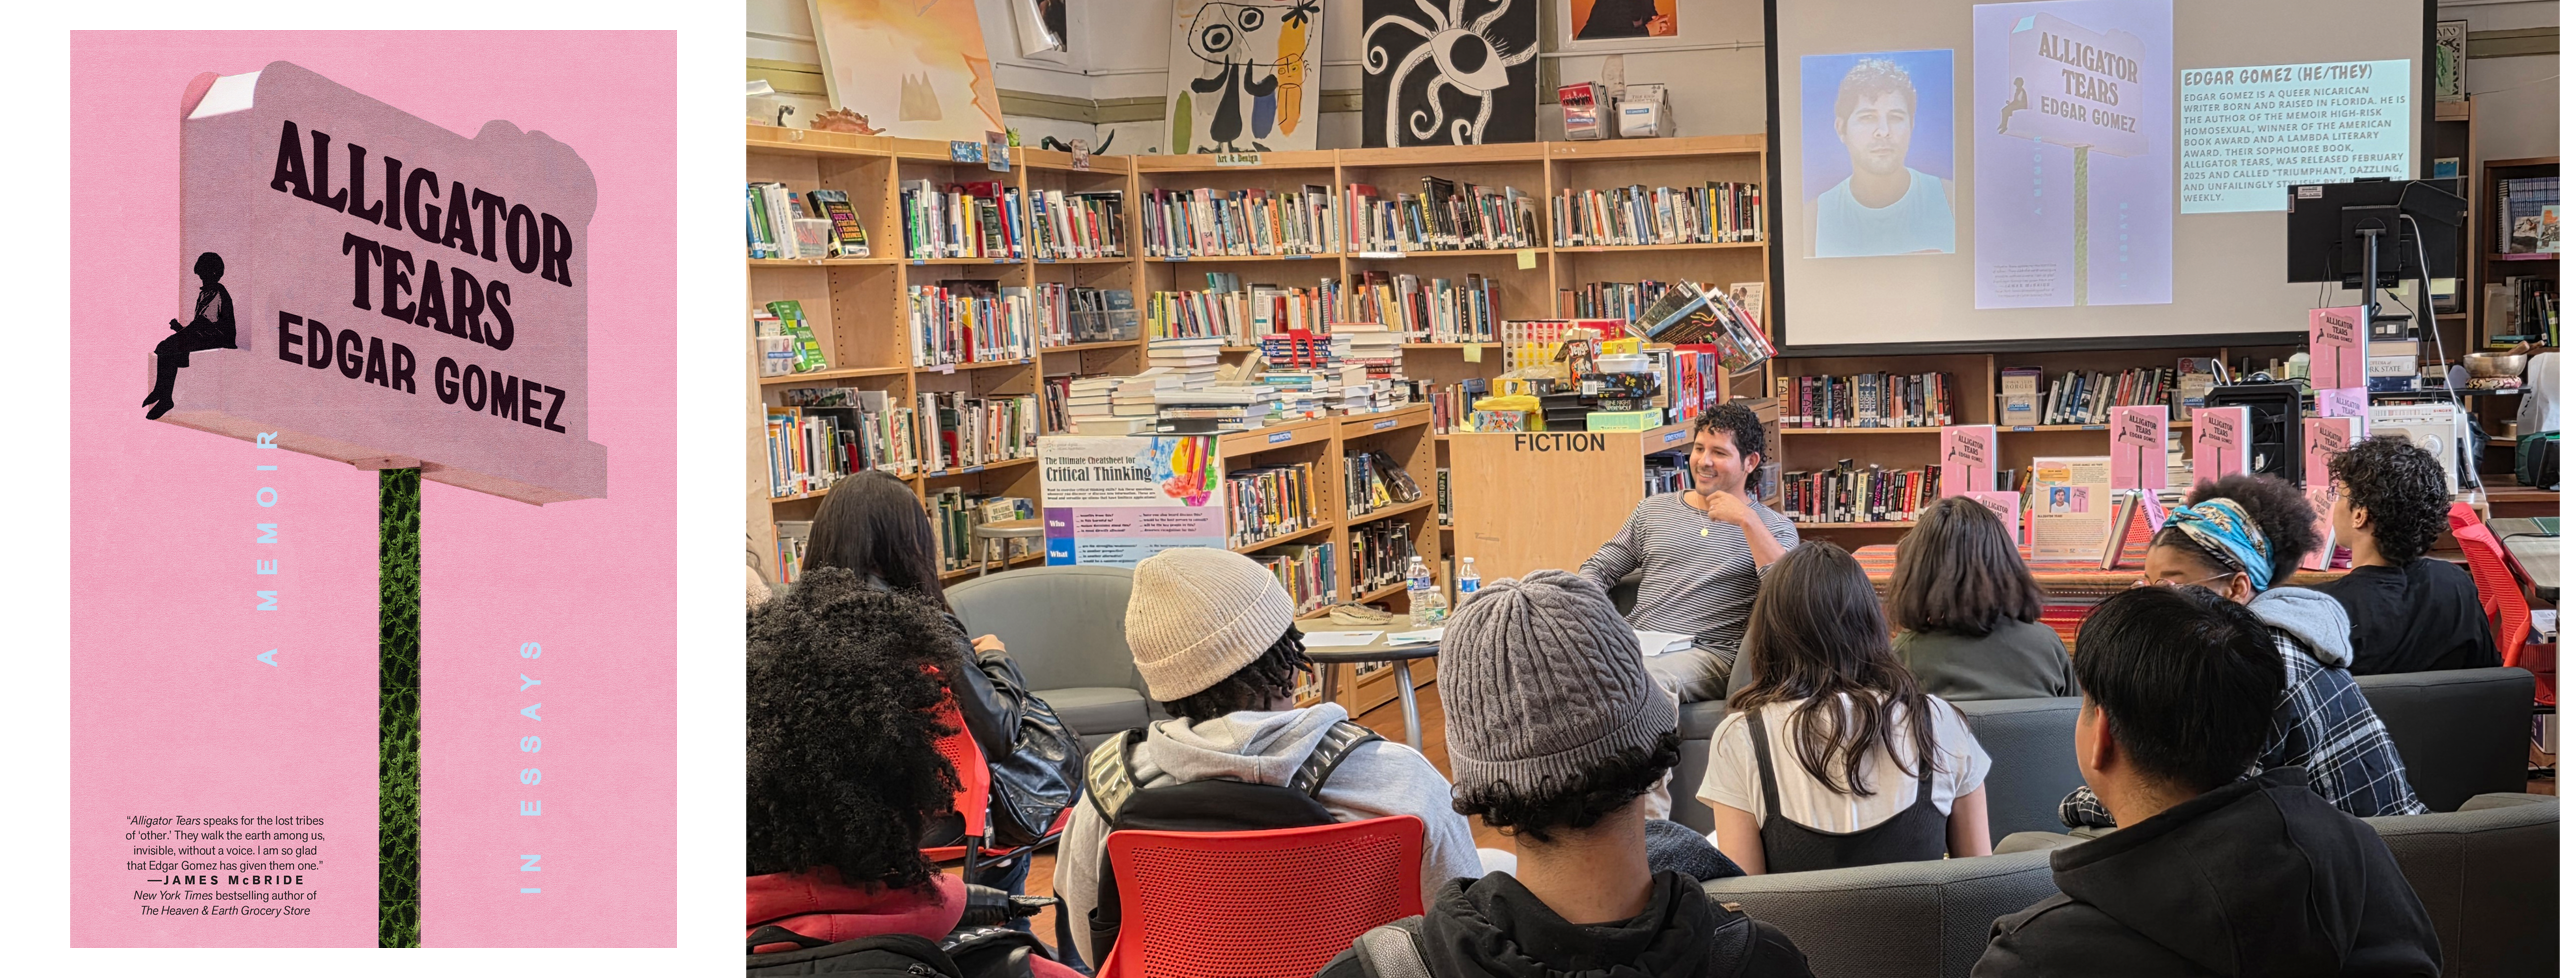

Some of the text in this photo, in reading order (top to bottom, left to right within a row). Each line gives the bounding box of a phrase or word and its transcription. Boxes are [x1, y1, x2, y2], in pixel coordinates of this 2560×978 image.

[2038, 32, 2138, 84] ALLIGATOR
[2184, 63, 2372, 87] EDGAR GOMEZ (HE/THEY)
[2062, 69, 2118, 106] TEARS
[2184, 93, 2216, 101] EDGAR
[2219, 91, 2253, 100] GOMEZ
[2256, 90, 2265, 98] IS
[2278, 88, 2310, 98] QUEER
[2313, 86, 2368, 95] NICARICAN
[2183, 103, 2220, 112] WRITER
[2223, 102, 2250, 110] BORN
[2253, 101, 2275, 109] AND
[2278, 99, 2313, 108] RAISED
[2330, 97, 2376, 106] FLORIDA.
[2396, 95, 2405, 103] IS
[2041, 96, 2136, 133] EDGAR GOMEZ
[2183, 108, 2381, 124] THE AUTHOR OF THE MEMOIR HIGH-RISK
[2184, 120, 2391, 135] HOMOSEXUAL, WINNER OF THE AMERICAN
[2184, 137, 2211, 146] BOOK
[2214, 136, 2250, 145] AWARD
[2252, 135, 2274, 143] AND
[2287, 133, 2328, 142] LAMBDA
[2332, 131, 2378, 140] LITERARY
[2183, 144, 2353, 157] AWARD. THEIR SOPHOMORE BOOK,
[1217, 153, 1258, 165] Art & Design
[2183, 152, 2403, 168] ALLIGATOR TEARS, WAS RELEASED FEBRUARY
[2183, 171, 2205, 180] 2025
[2208, 170, 2230, 179] AND
[2232, 169, 2269, 178] CALLED
[2349, 164, 2401, 173] DAZZLING,
[2208, 182, 2273, 191] UNFAILINGLY
[270, 120, 573, 287] ALLIGATOR
[2184, 193, 2223, 202] WEEKLY.
[342, 231, 514, 351] TEARS
[2326, 316, 2353, 330] ALLIGATOR
[2332, 325, 2348, 337] TEARS
[1569, 341, 1589, 358] Jenga
[278, 310, 566, 434] EDGAR GOMEZ
[2381, 365, 2401, 373] STATE
[2336, 397, 2360, 410] ALLIGATOR
[2129, 415, 2157, 430] ALLIGATOR
[2135, 425, 2151, 435] TEARS
[2208, 417, 2233, 431] ALLIGATOR
[2214, 427, 2228, 437] TEARS
[2319, 427, 2342, 443] ALLIGATOR
[1515, 433, 1605, 452] FICTION
[1958, 435, 1984, 450] ALLIGATOR
[1964, 445, 1979, 456] TEARS
[1045, 456, 1135, 465] The Ultimate Cheatsheet for
[1046, 466, 1152, 482] Critical Thinking
[256, 430, 278, 667] A MEMOIR
[520, 641, 542, 894] IN ESSAYS
[176, 816, 200, 825] Tears
[203, 816, 238, 827] speaks
[240, 816, 254, 825] for
[256, 816, 272, 825] the
[275, 816, 293, 825] lost
[295, 816, 324, 825] tribes
[125, 830, 135, 840] of
[174, 830, 198, 842] They
[200, 830, 224, 840] walk
[226, 830, 242, 840] the
[245, 830, 270, 840] earth
[273, 832, 308, 842] among
[311, 832, 324, 842] us,
[134, 845, 175, 856] invisible,
[178, 845, 215, 855] without
[226, 845, 254, 855] voice.
[258, 845, 260, 854] I
[295, 845, 316, 857] glad
[126, 860, 146, 870] that
[149, 860, 178, 872] Edgar
[181, 860, 216, 870] Gomez
[220, 860, 237, 870] has
[240, 860, 266, 872] given
[269, 860, 294, 870] them
[228, 875, 302, 884] McBRIDE
[133, 890, 316, 902] New York Times bestselling author of
[141, 905, 310, 918] The Heaven & Earth Grocery Store
